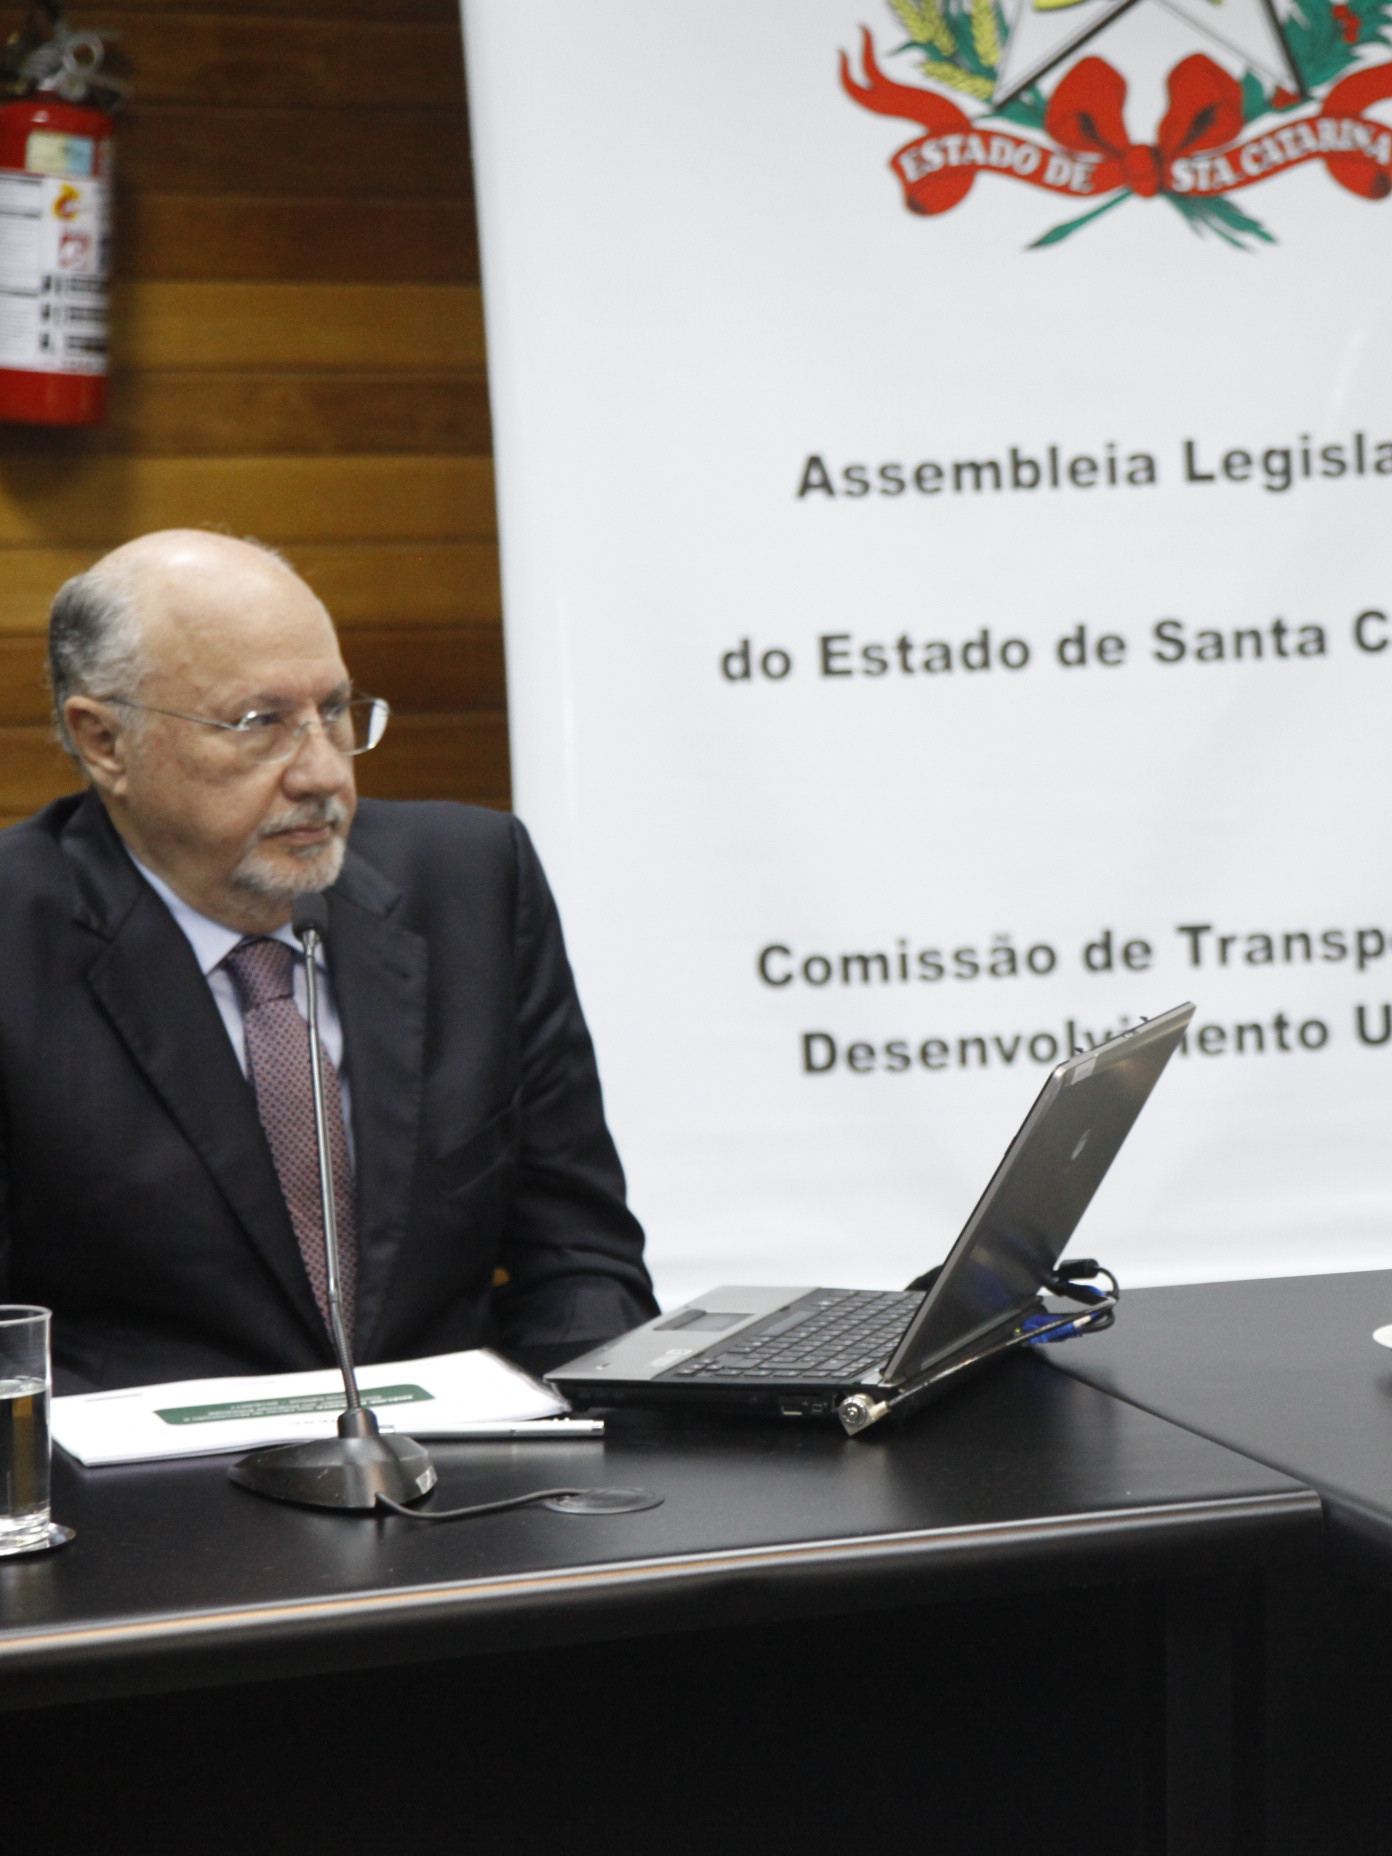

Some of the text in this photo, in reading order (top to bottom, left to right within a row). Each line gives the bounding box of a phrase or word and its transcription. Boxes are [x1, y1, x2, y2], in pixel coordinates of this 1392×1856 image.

[900, 133, 1041, 183] ESTADO
[1044, 154, 1095, 194] DE
[797, 443, 1157, 498] Assembleia
[721, 639, 793, 681] do
[820, 628, 1030, 677] Estado
[1057, 623, 1127, 667] de
[1154, 616, 1326, 663] Santa
[758, 934, 1058, 988] Comissão
[1083, 929, 1153, 972] de
